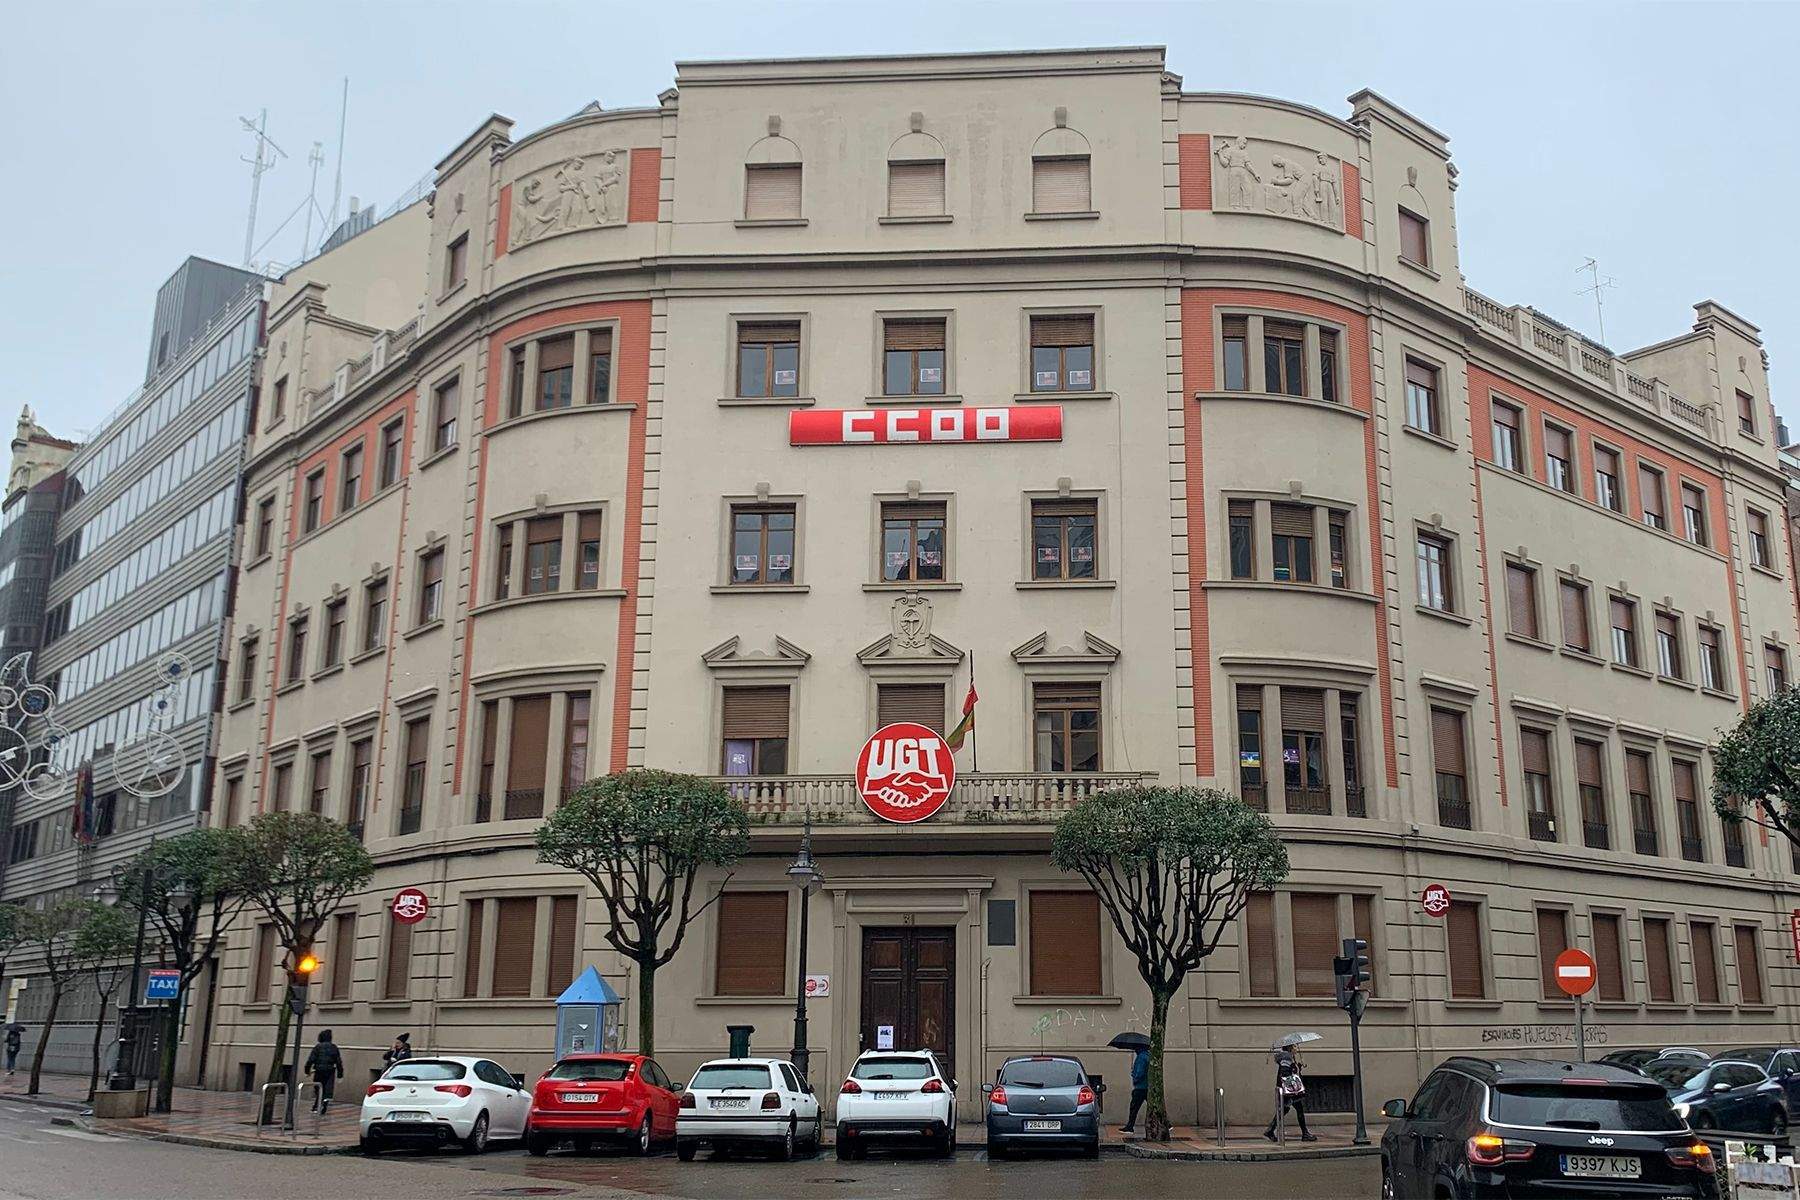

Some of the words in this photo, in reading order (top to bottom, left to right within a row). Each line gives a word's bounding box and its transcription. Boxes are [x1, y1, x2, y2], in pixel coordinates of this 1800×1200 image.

[843, 409, 1010, 442] CCOO
[867, 738, 941, 779] UGT
[150, 979, 178, 989] TAXI
[1587, 1135, 1615, 1147] Jeep
[1570, 1156, 1605, 1172] 9397
[1610, 1158, 1639, 1173] KJS
